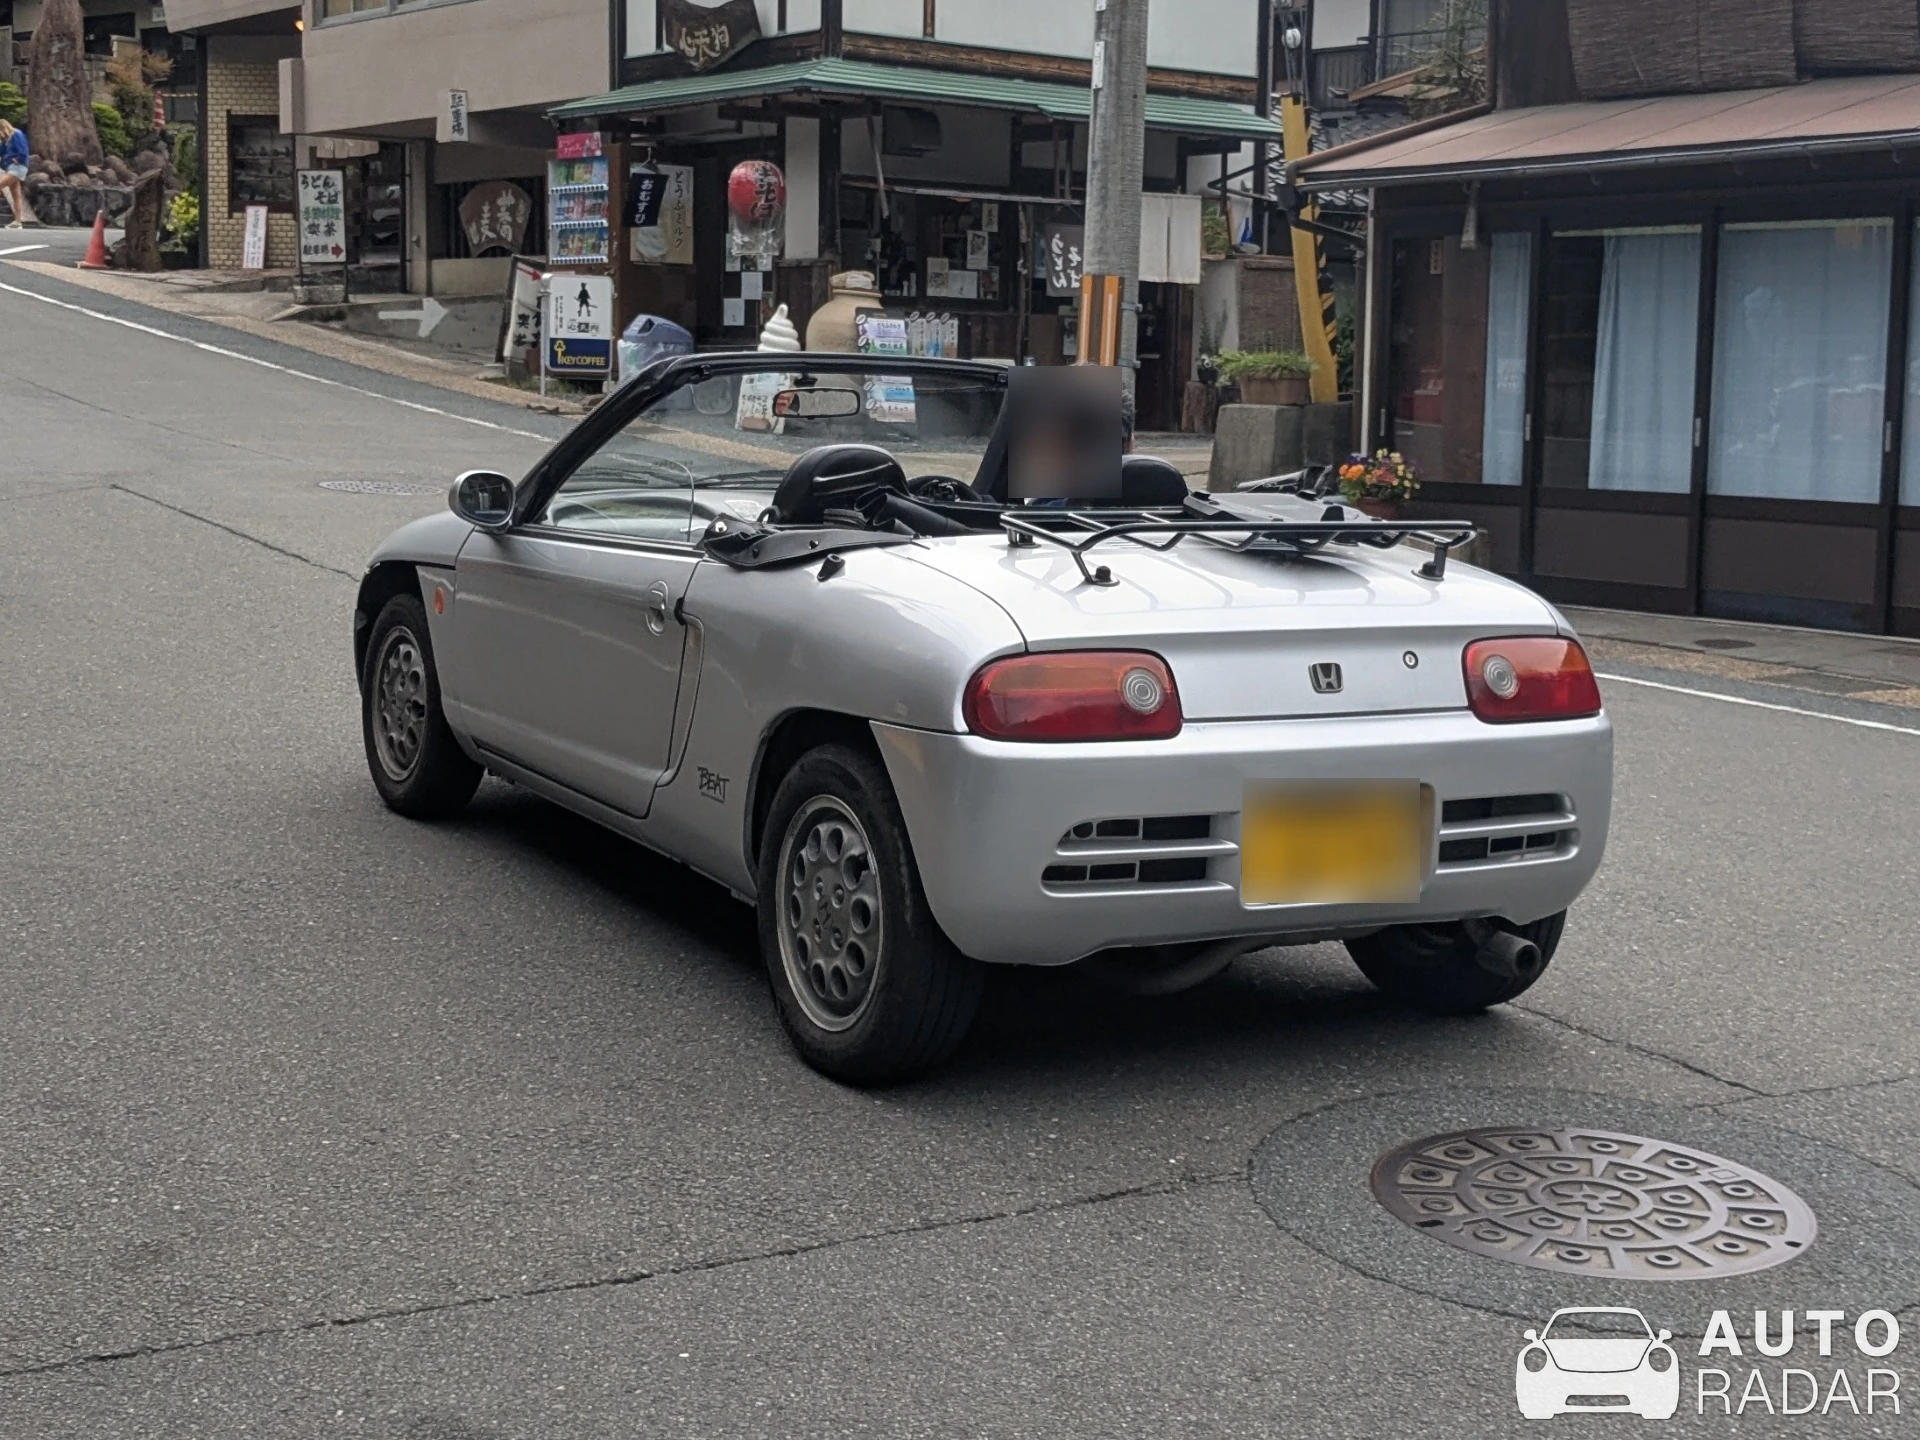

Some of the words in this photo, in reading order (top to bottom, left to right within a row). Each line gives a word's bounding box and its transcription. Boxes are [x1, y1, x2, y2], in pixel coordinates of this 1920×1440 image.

[301, 175, 336, 189] うどん
[315, 191, 340, 205] そば
